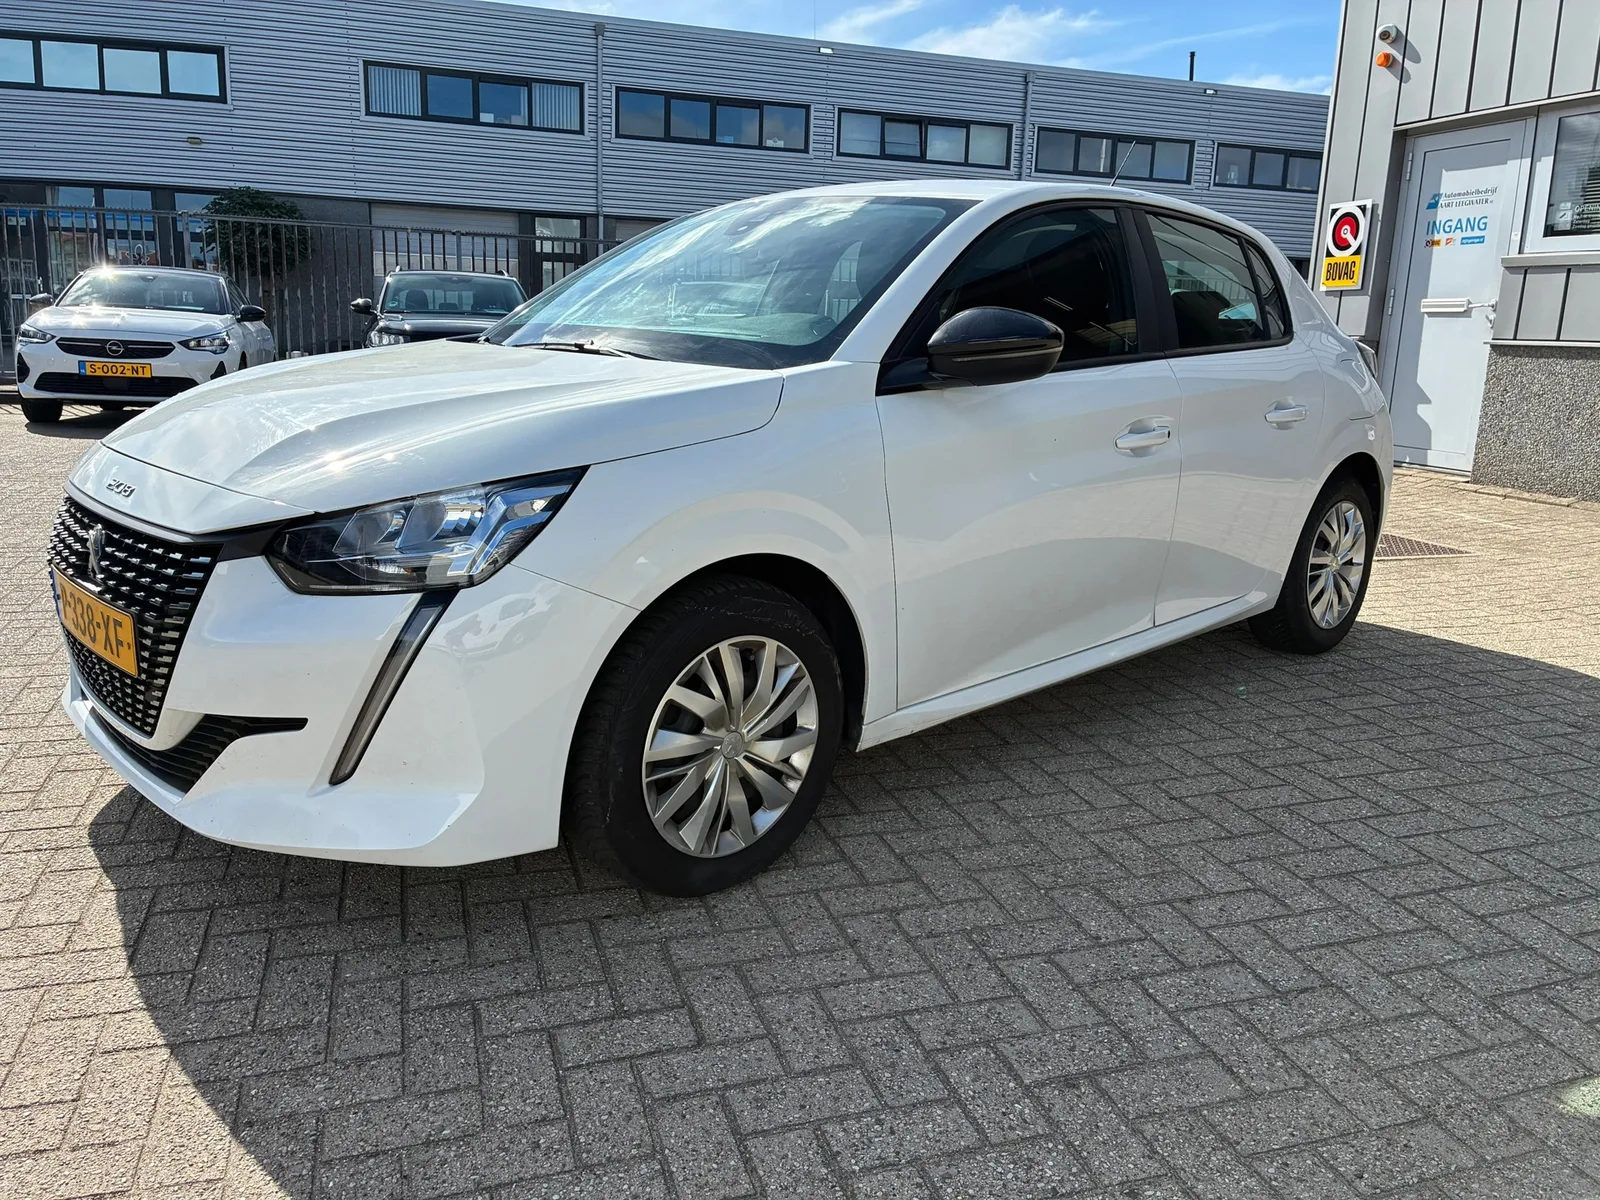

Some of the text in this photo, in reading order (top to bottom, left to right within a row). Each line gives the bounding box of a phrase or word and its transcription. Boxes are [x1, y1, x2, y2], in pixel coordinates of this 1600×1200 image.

[1444, 186, 1498, 199] Automobielbedrijf
[1426, 216, 1488, 235] INGANG
[1325, 260, 1356, 281] BOVAG
[89, 363, 147, 376] S-002-NT
[106, 478, 136, 498] 208
[61, 583, 124, 658] P-338-XF
